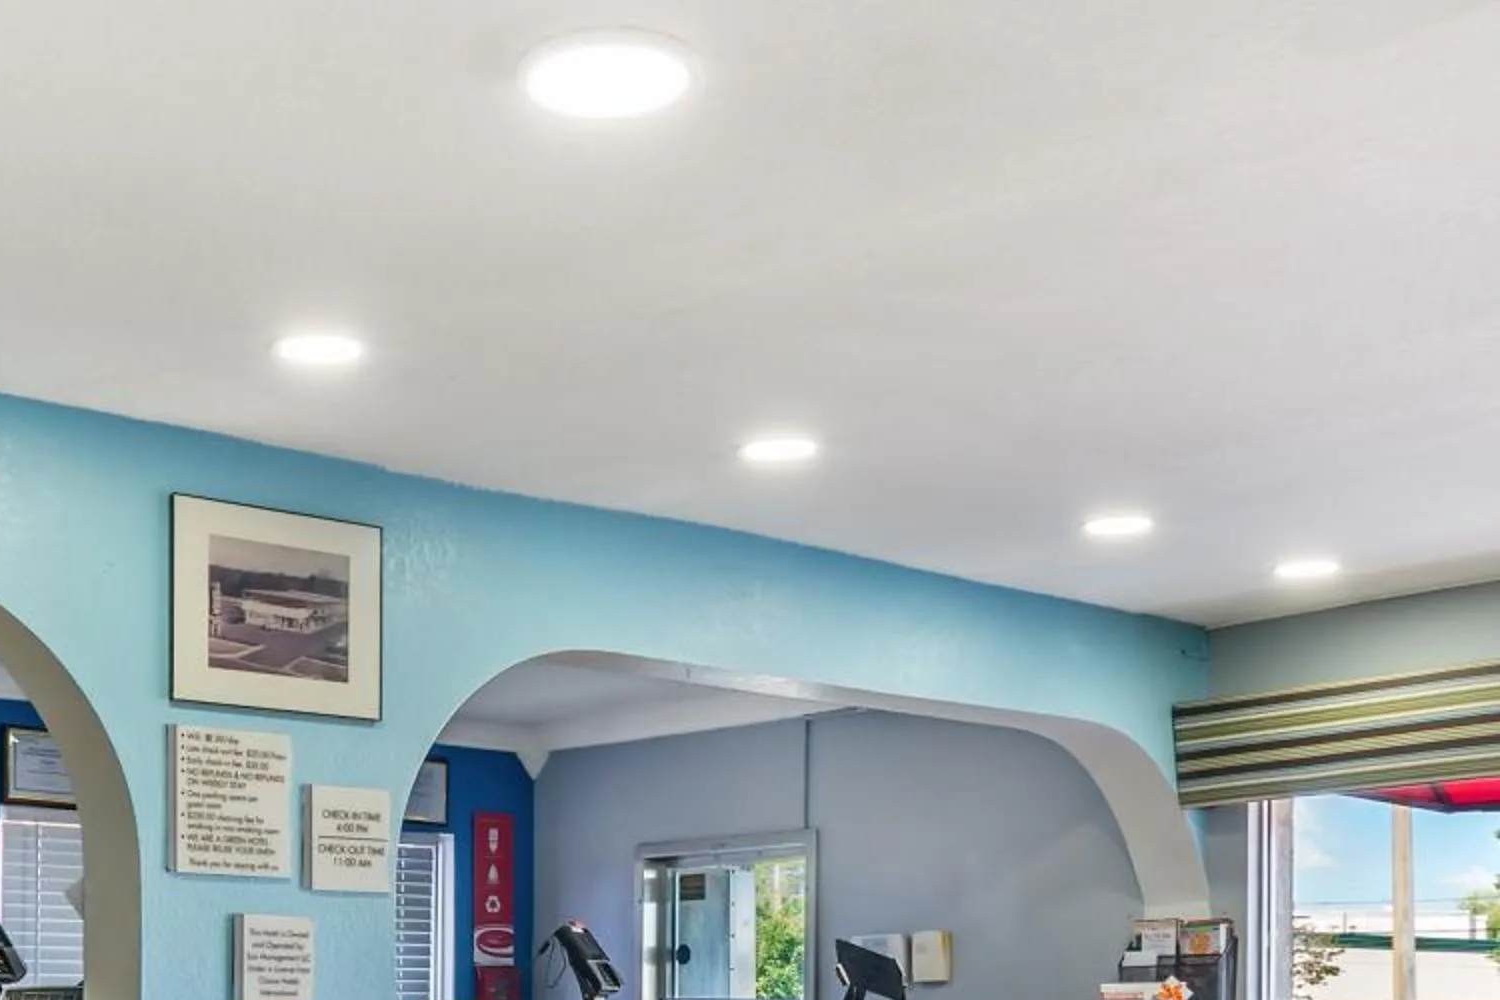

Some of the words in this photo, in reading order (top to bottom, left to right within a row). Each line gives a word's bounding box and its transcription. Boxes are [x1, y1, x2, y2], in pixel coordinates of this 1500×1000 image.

[322, 809, 349, 821] CHECK
[352, 811, 363, 821] IN
[363, 811, 382, 823] TIME
[318, 843, 345, 855] CHECK
[347, 845, 366, 856] OUT
[366, 846, 385, 857] TIME
[333, 856, 357, 867] 11:00
[358, 857, 372, 868] AM
